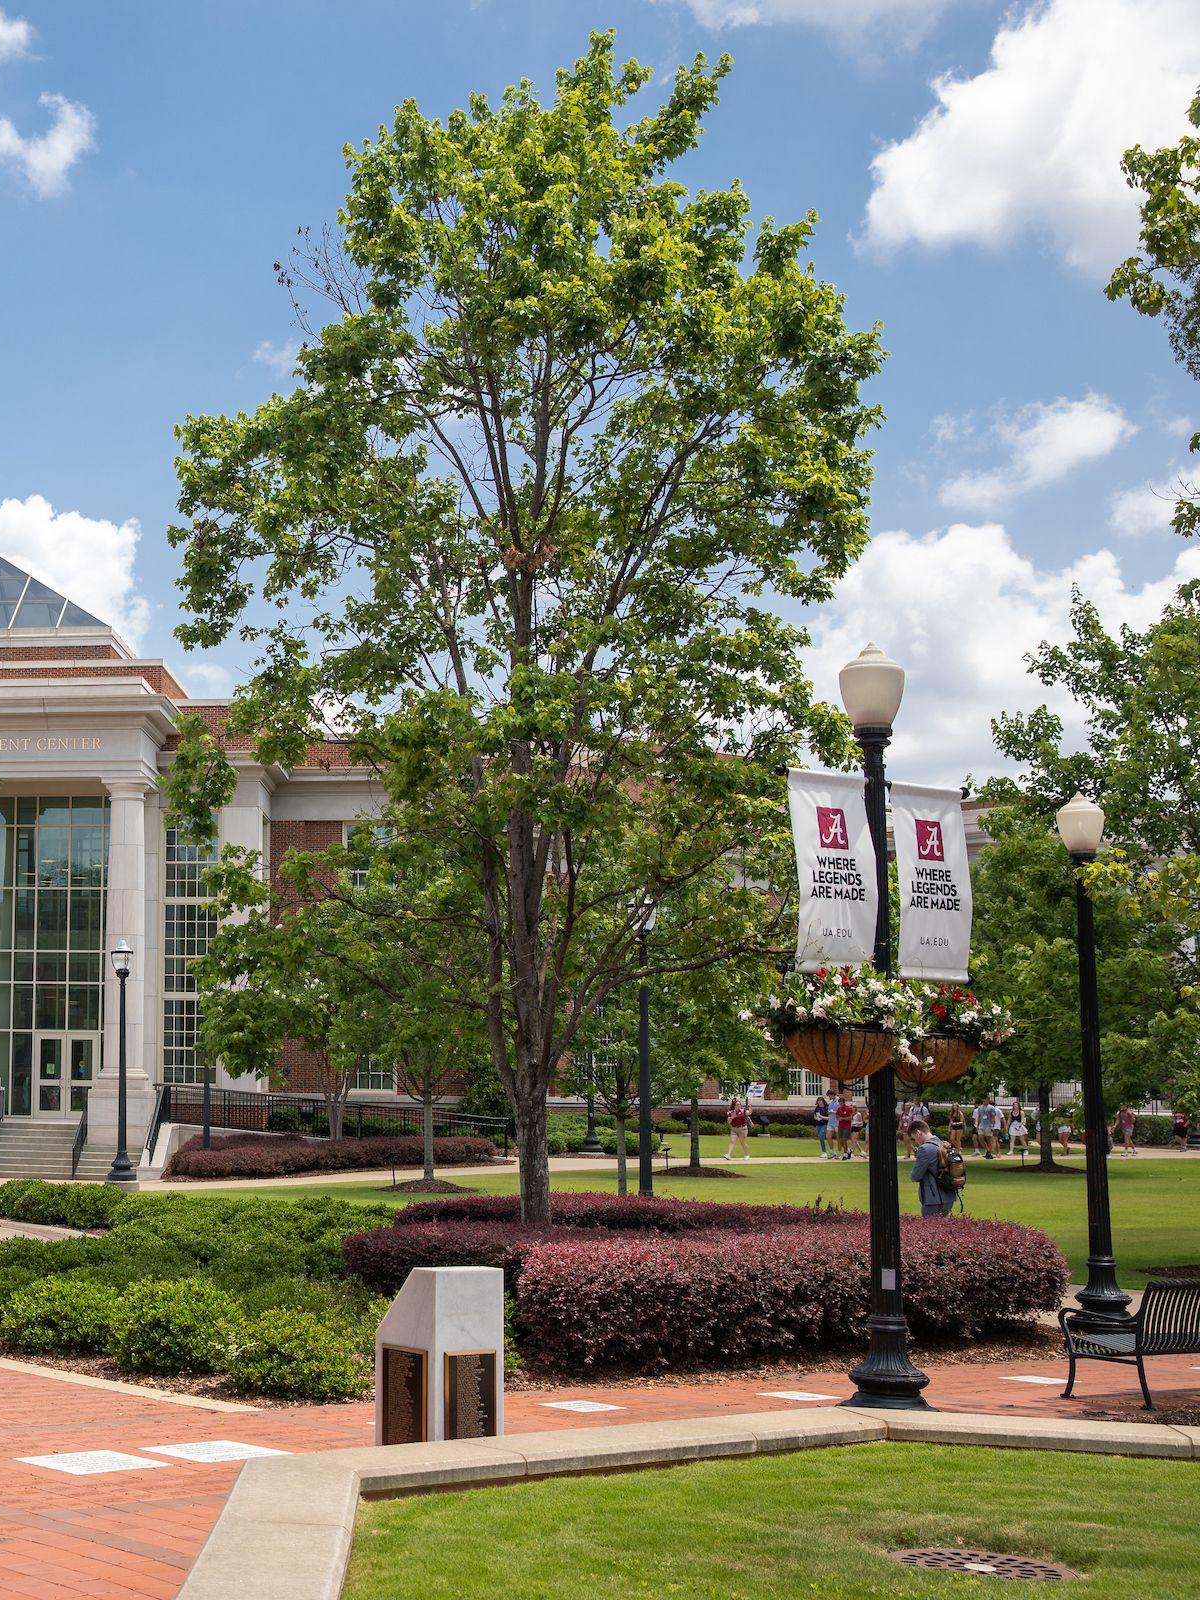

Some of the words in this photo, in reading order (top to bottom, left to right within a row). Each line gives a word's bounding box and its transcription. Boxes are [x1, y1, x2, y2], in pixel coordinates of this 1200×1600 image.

[36, 737, 102, 751] CENTER
[816, 855, 857, 872] WHERE
[812, 869, 863, 887] LEGENDS
[914, 866, 952, 883] WHERE
[810, 885, 833, 899] ARE
[911, 881, 958, 898] LEGENDS
[909, 895, 930, 910] ARE
[822, 927, 853, 939] UA.EDU
[919, 935, 950, 948] UA.EDU
